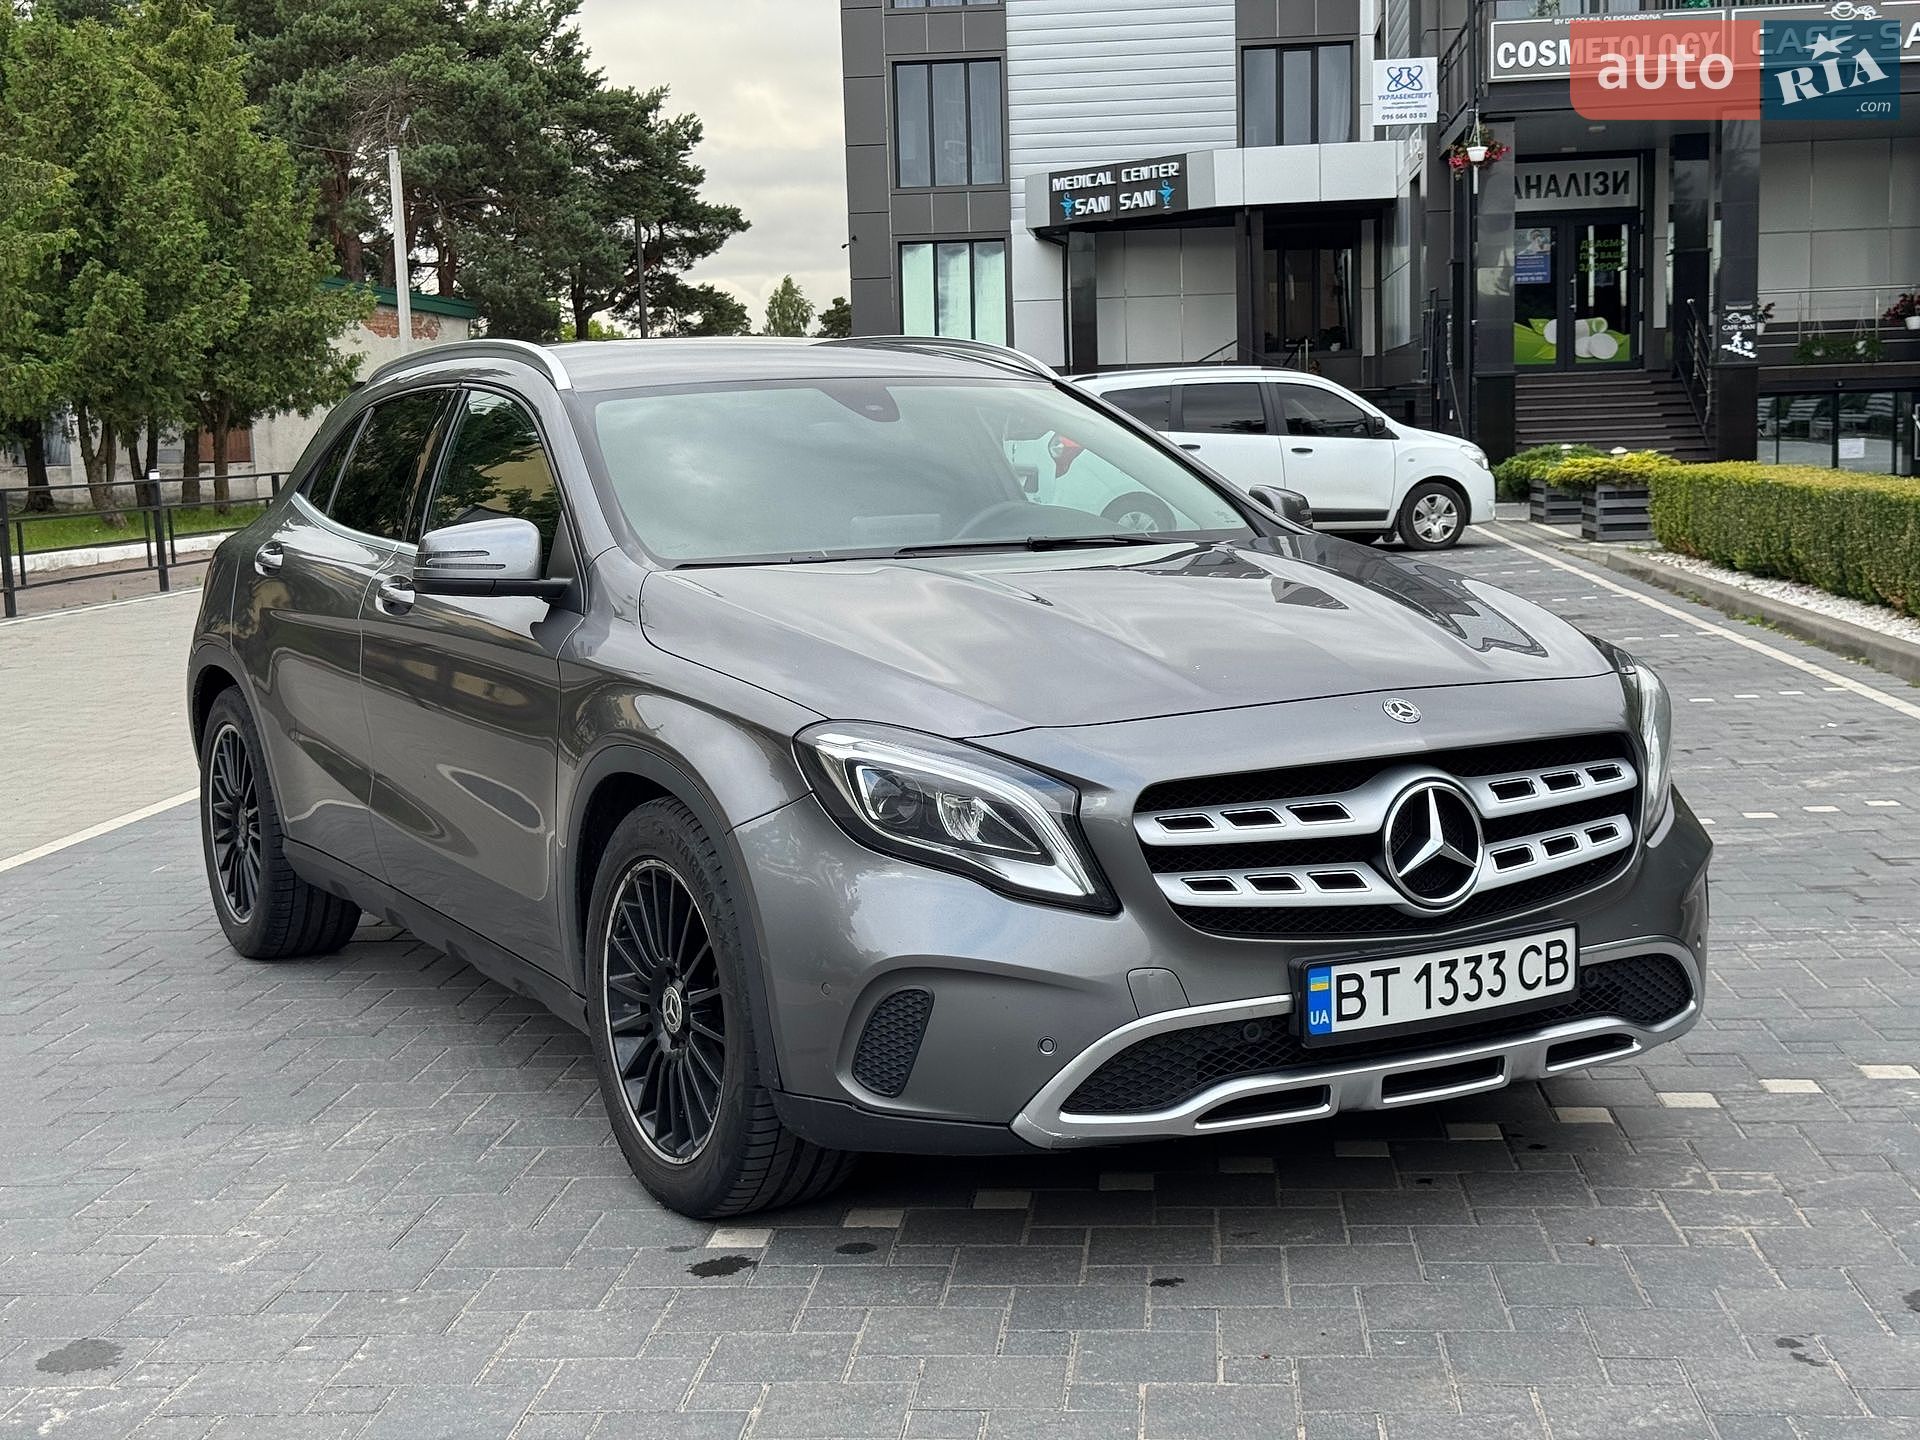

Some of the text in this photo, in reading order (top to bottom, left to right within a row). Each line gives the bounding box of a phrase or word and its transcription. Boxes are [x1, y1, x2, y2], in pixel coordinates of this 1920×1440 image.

[1496, 32, 1720, 69] COSMETOLOGY
[1052, 162, 1180, 192] MEDICAL CENTER
[1074, 189, 1157, 216] SAN SAN
[1336, 939, 1570, 1022] BT 1333 CB
[1310, 1009, 1330, 1026] UA
